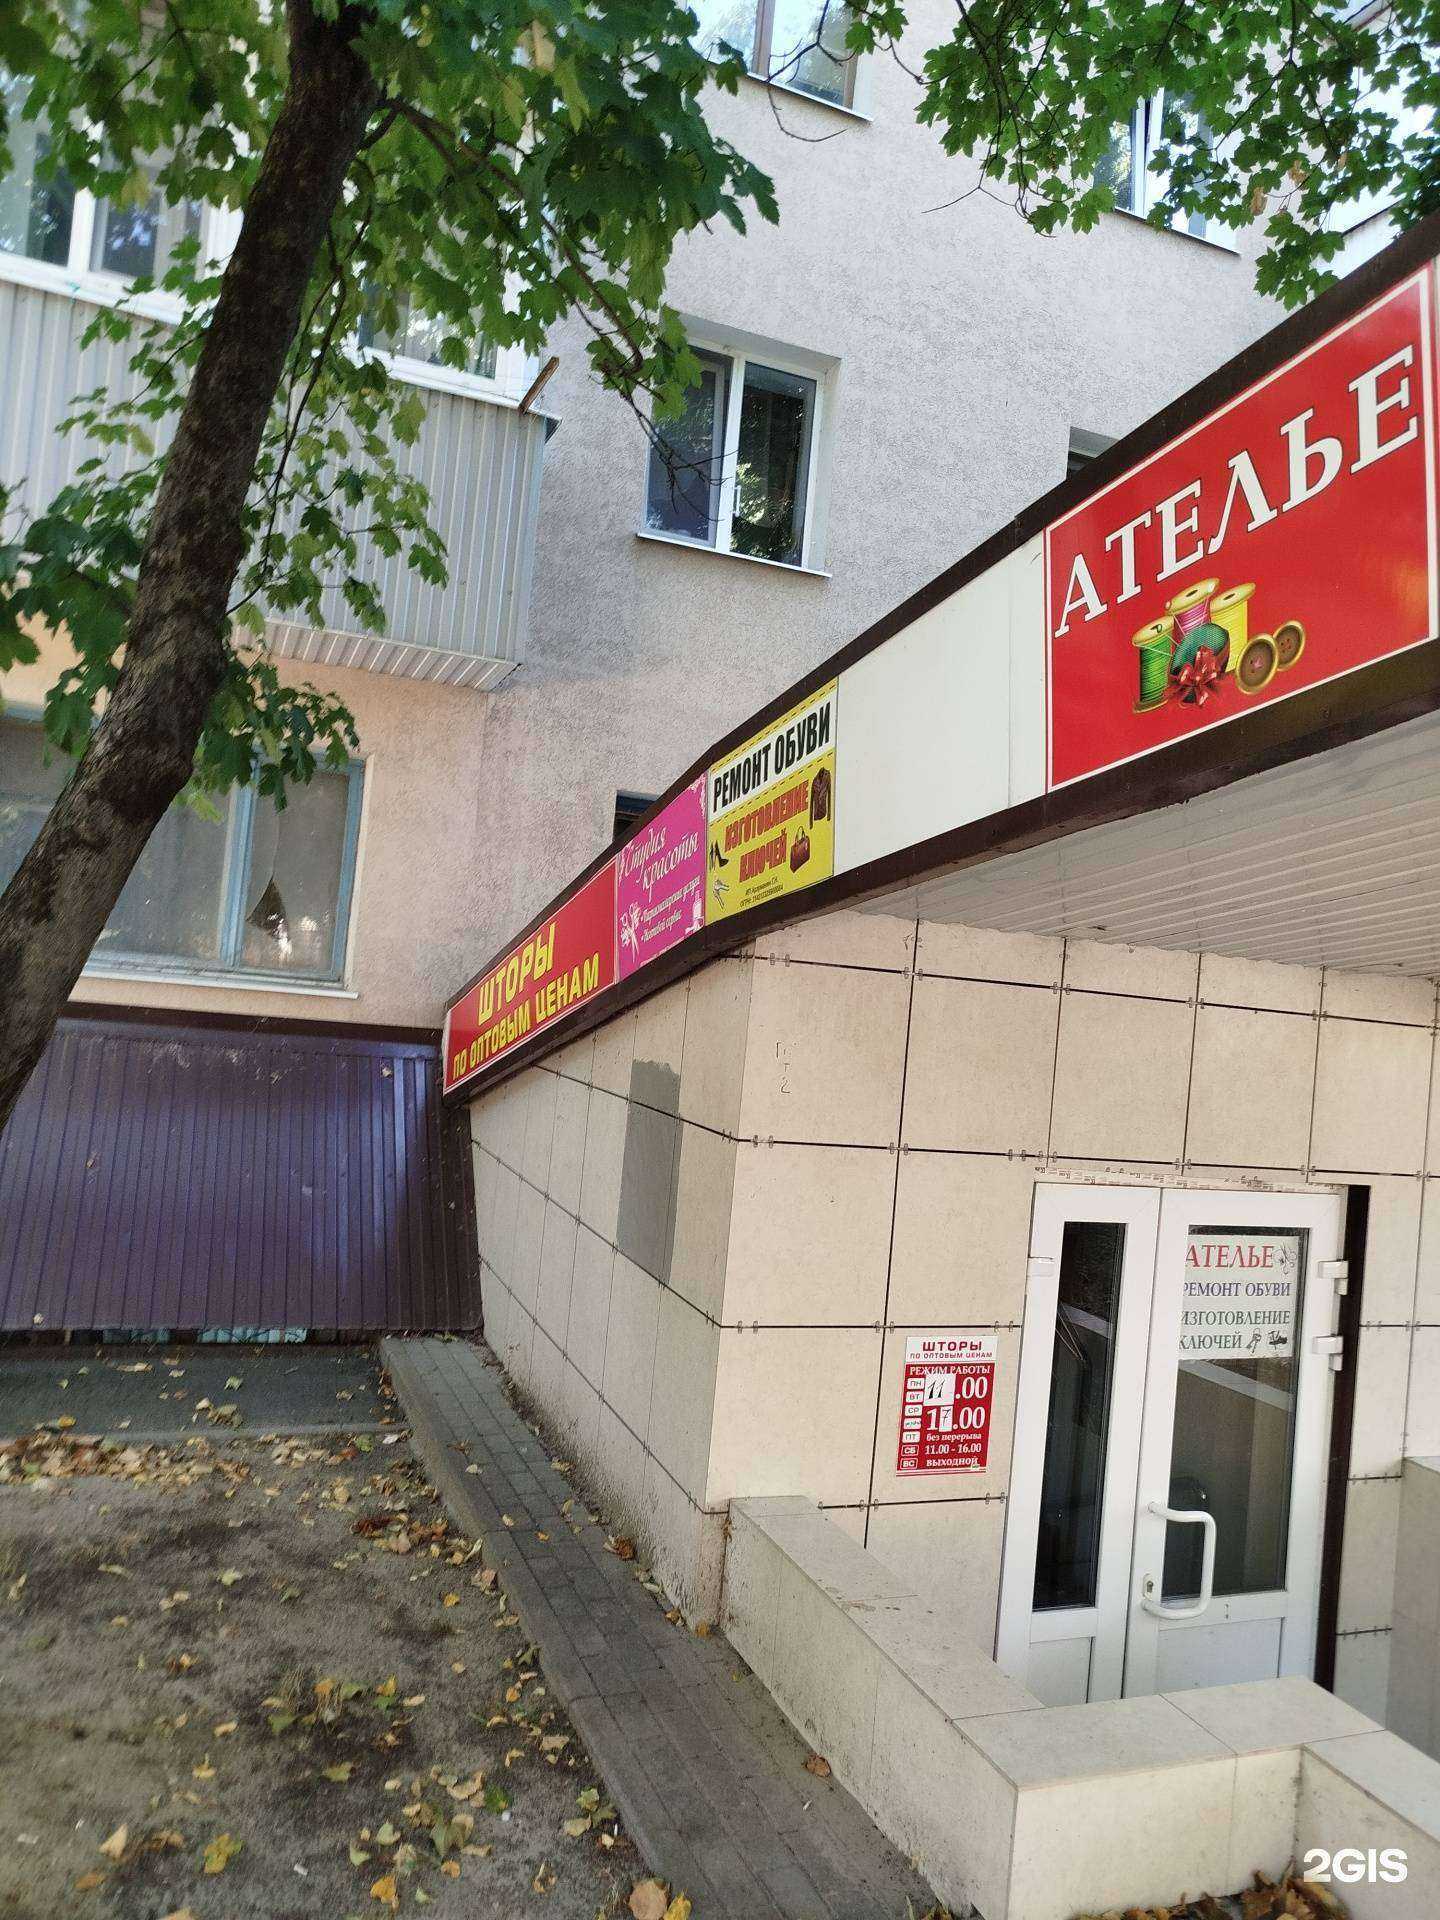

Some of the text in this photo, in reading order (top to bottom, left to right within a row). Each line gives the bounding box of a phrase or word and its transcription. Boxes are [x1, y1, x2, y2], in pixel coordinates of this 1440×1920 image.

[1054, 344, 1420, 639] АТЕЛЬЕ
[712, 702, 831, 813] РЕМОНТ ОБУВИ
[724, 779, 809, 853] ИЗГОТОВЛЕНИЕ
[739, 827, 787, 883] КЛЮЧЕЙ
[642, 832, 699, 903] красоты
[478, 922, 556, 1026] ШТОРЫ
[452, 952, 600, 1081] ПО ОПТОВЫМ ЦЕНАМ
[1185, 1245, 1275, 1268] АТЕЛЬЕ
[1245, 1282, 1291, 1297] ОБУВИ
[922, 1341, 982, 1352] ШТОРЫ
[909, 1365, 991, 1376] РЕЖИМ РАБОТЫ
[910, 1392, 921, 1400] ВТ
[905, 1433, 917, 1441] ПТ
[925, 1444, 950, 1455] 11.00
[957, 1442, 982, 1453] 16.00
[926, 1433, 982, 1443] без перерыва
